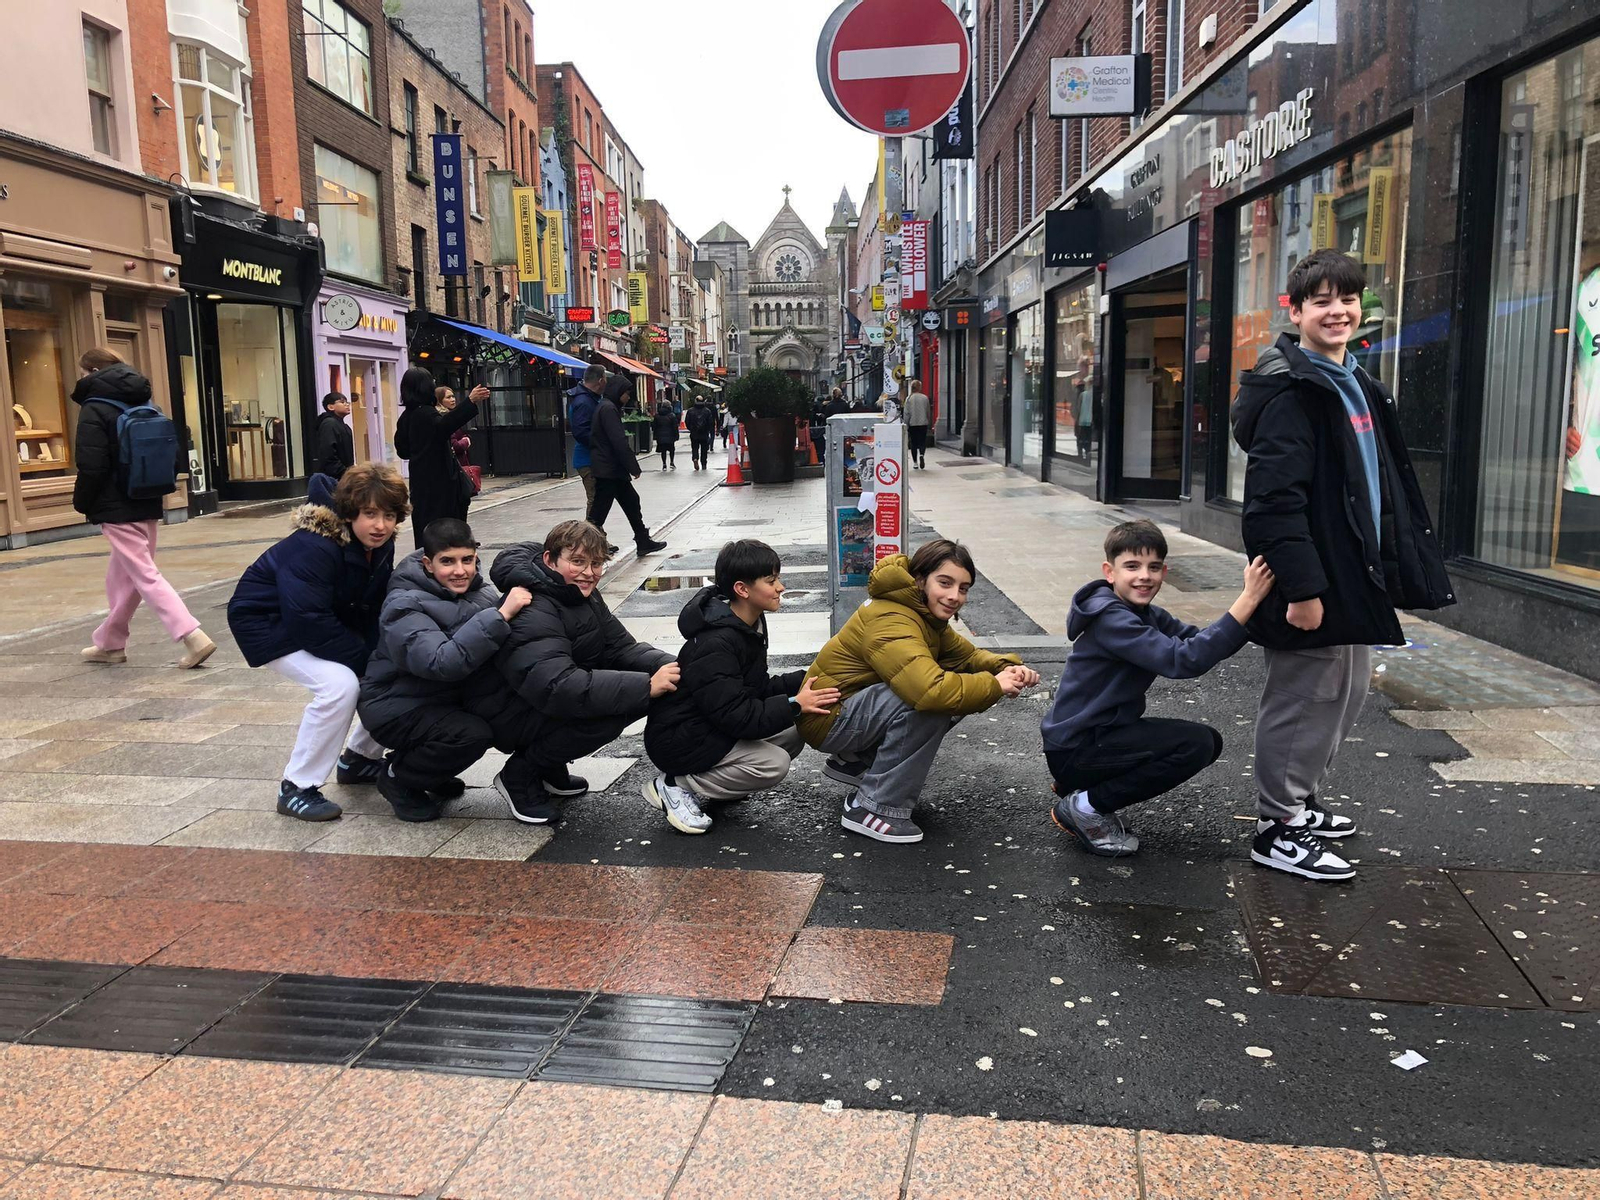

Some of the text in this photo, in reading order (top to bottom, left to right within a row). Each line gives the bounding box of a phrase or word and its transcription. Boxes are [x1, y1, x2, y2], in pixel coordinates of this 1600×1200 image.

[1092, 77, 1131, 86] Medical
[1093, 66, 1128, 76] Grafton
[1209, 87, 1313, 188] CASTORE
[440, 142, 460, 268] BUNSEN
[521, 195, 529, 223] GOURMET
[525, 249, 533, 275] KITCHEN
[902, 222, 914, 274] WHISTLE
[914, 222, 926, 271] BLOWER
[1052, 253, 1094, 261] JIGSAW
[222, 258, 282, 286] MONTBLANC
[630, 278, 644, 306] GOTHAM
[331, 299, 353, 308] ASTRID
[334, 317, 354, 326] MIYU
[380, 316, 398, 332] MIYU
[609, 313, 629, 325] EAT
